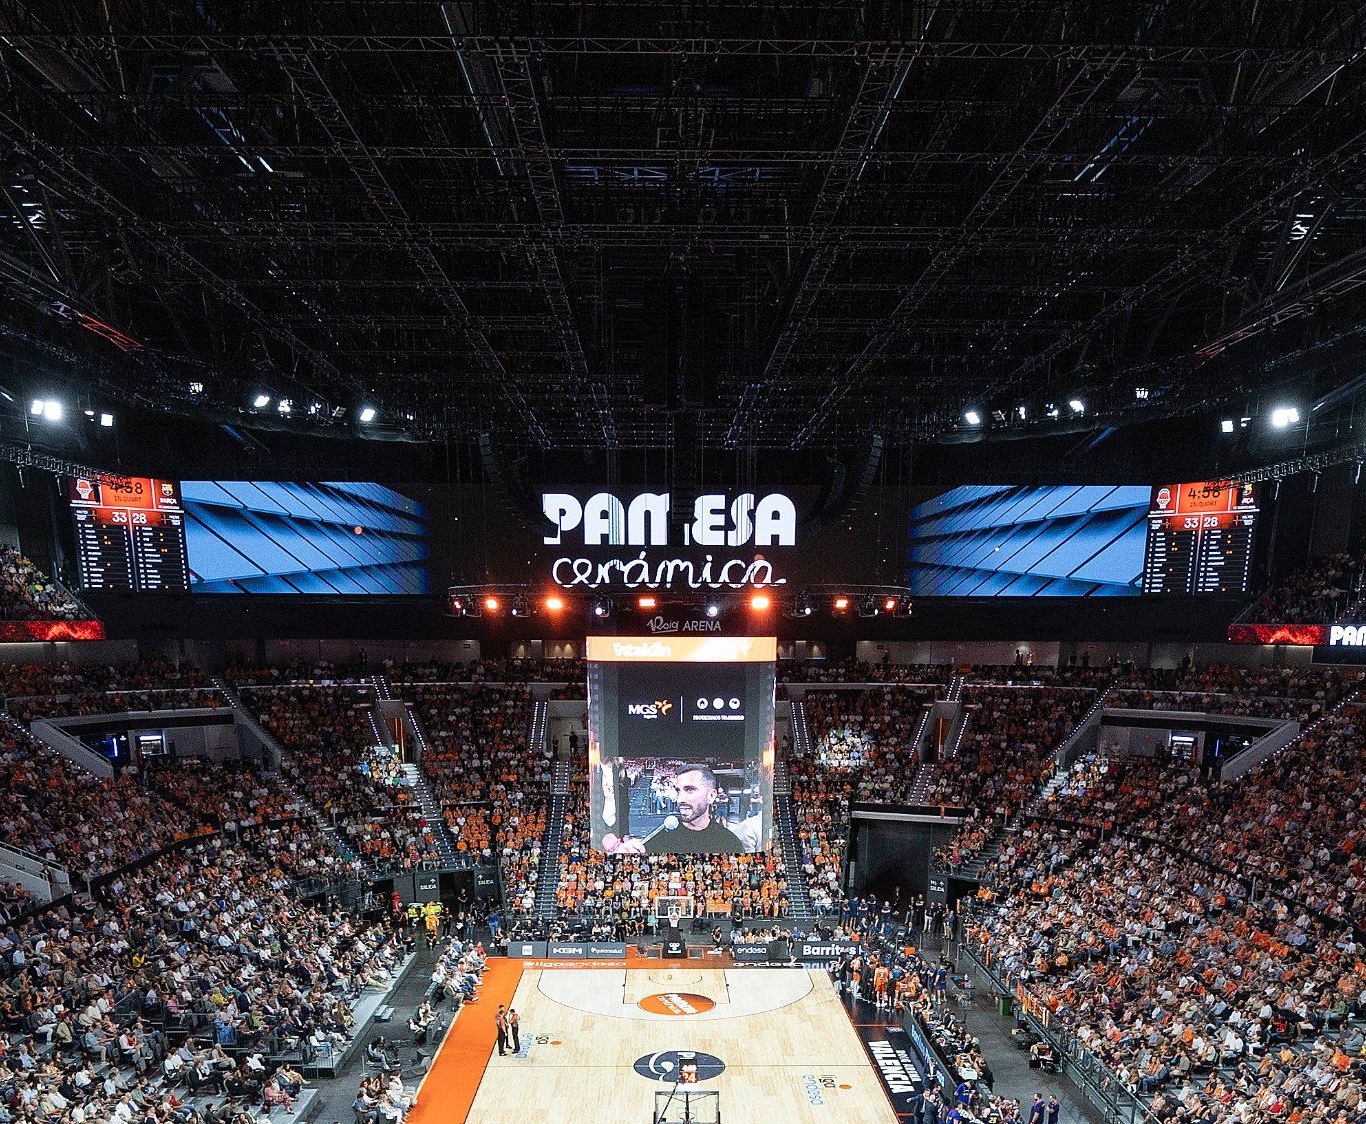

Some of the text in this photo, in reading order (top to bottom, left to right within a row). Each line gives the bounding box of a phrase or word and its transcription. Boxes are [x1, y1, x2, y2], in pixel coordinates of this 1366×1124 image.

[112, 512, 127, 523] 33
[132, 513, 147, 524] 28
[1184, 518, 1199, 528] 33
[1204, 517, 1218, 528] 28
[553, 551, 786, 588] cerámica
[647, 615, 722, 634] Roig ARENA
[629, 704, 657, 715] MGS
[736, 947, 768, 955] endesa
[868, 1040, 915, 1093] VALENCIA
